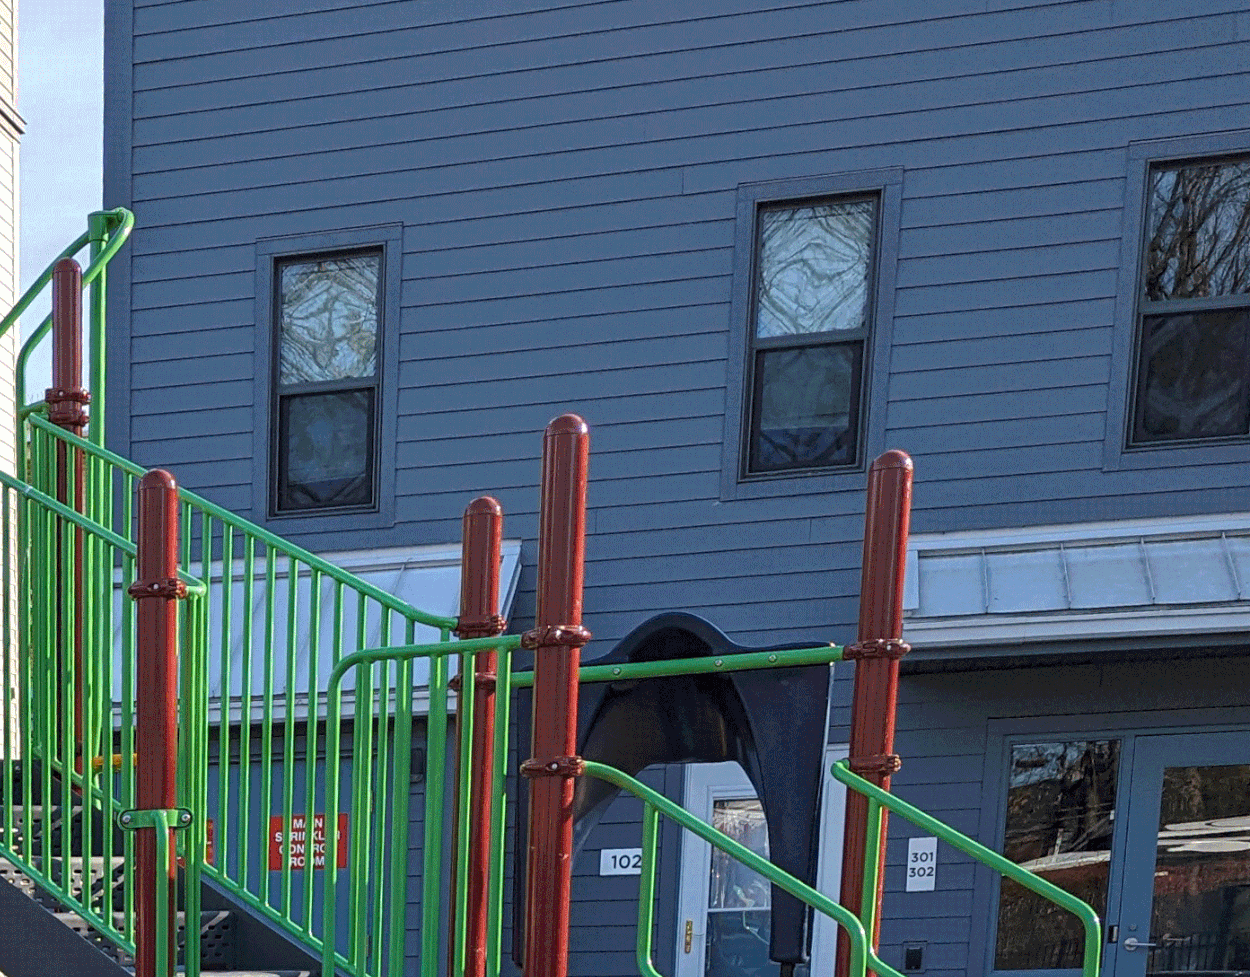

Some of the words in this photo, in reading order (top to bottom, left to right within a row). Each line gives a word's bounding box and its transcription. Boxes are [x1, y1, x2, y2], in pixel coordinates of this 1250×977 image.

[293, 818, 323, 829] MN
[289, 856, 326, 867] ROM
[611, 854, 642, 869] 102
[911, 851, 934, 863] 301
[908, 866, 934, 878] 302
